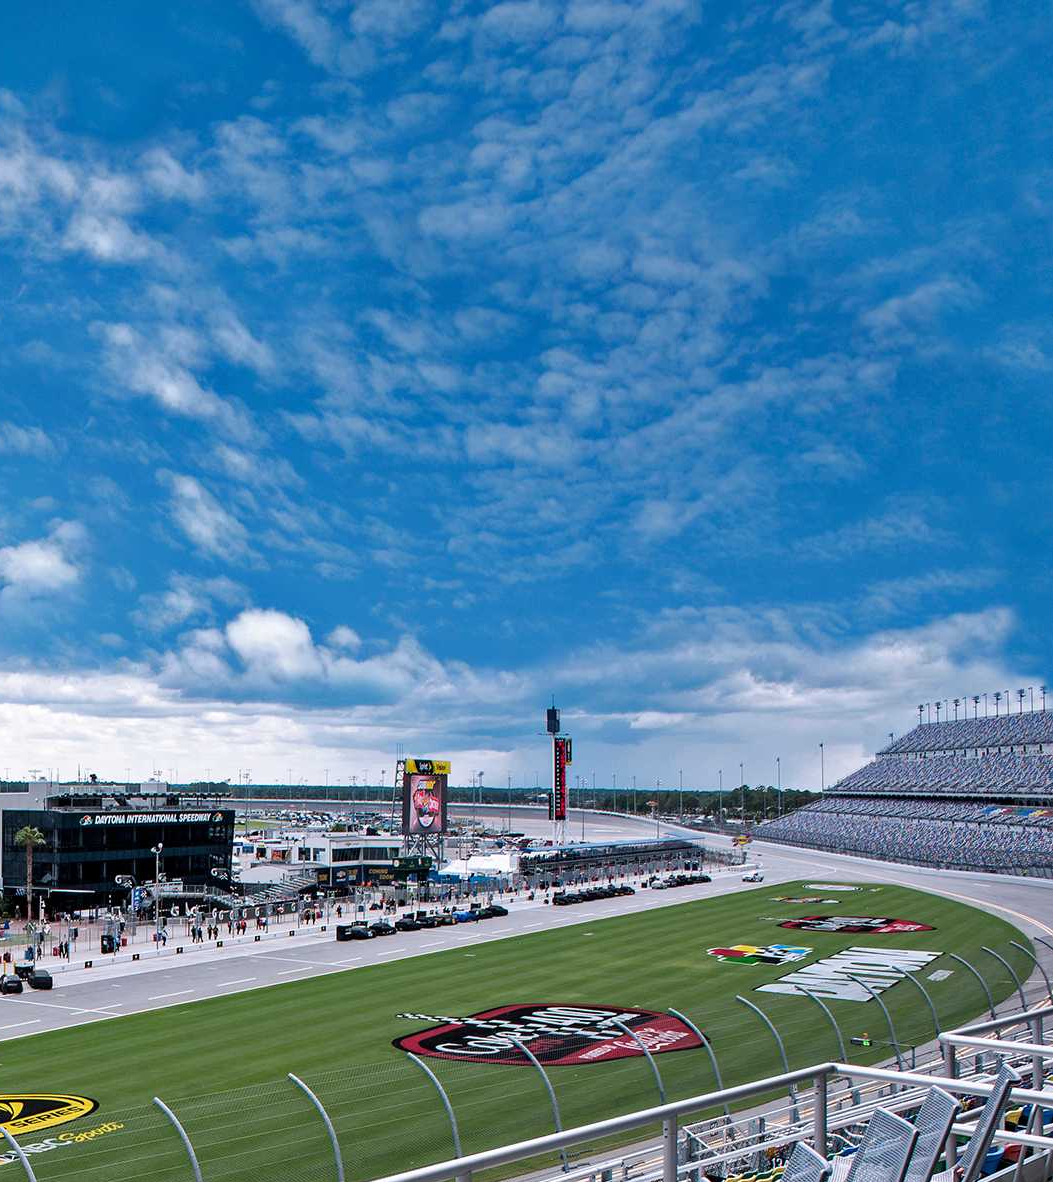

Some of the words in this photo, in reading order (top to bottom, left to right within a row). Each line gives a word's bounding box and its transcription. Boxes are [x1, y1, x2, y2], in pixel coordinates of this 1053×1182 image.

[95, 814, 126, 825] DAYTONA
[126, 814, 178, 824] INTERNATIONAL
[179, 812, 212, 822] SPEEDWAY
[435, 1031, 540, 1055] Coke
[10, 1105, 85, 1129] SERIES
[58, 1121, 125, 1144] Sports
